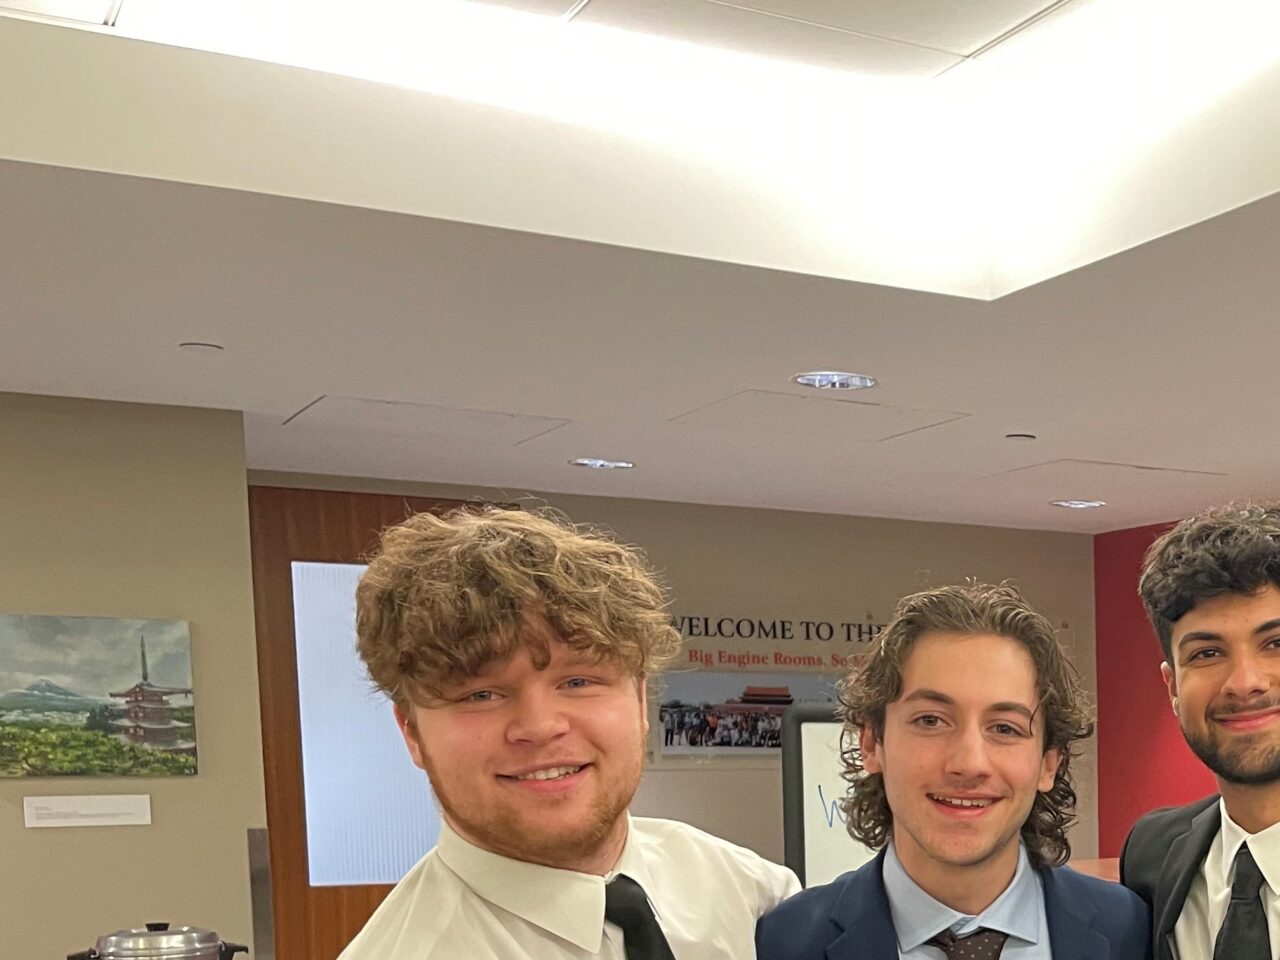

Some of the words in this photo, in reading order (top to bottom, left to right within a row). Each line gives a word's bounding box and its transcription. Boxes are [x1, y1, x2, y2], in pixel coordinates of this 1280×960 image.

[669, 616, 794, 640] WELCOME
[800, 621, 835, 641] TO
[688, 649, 713, 668] Big
[718, 651, 769, 668] Engine
